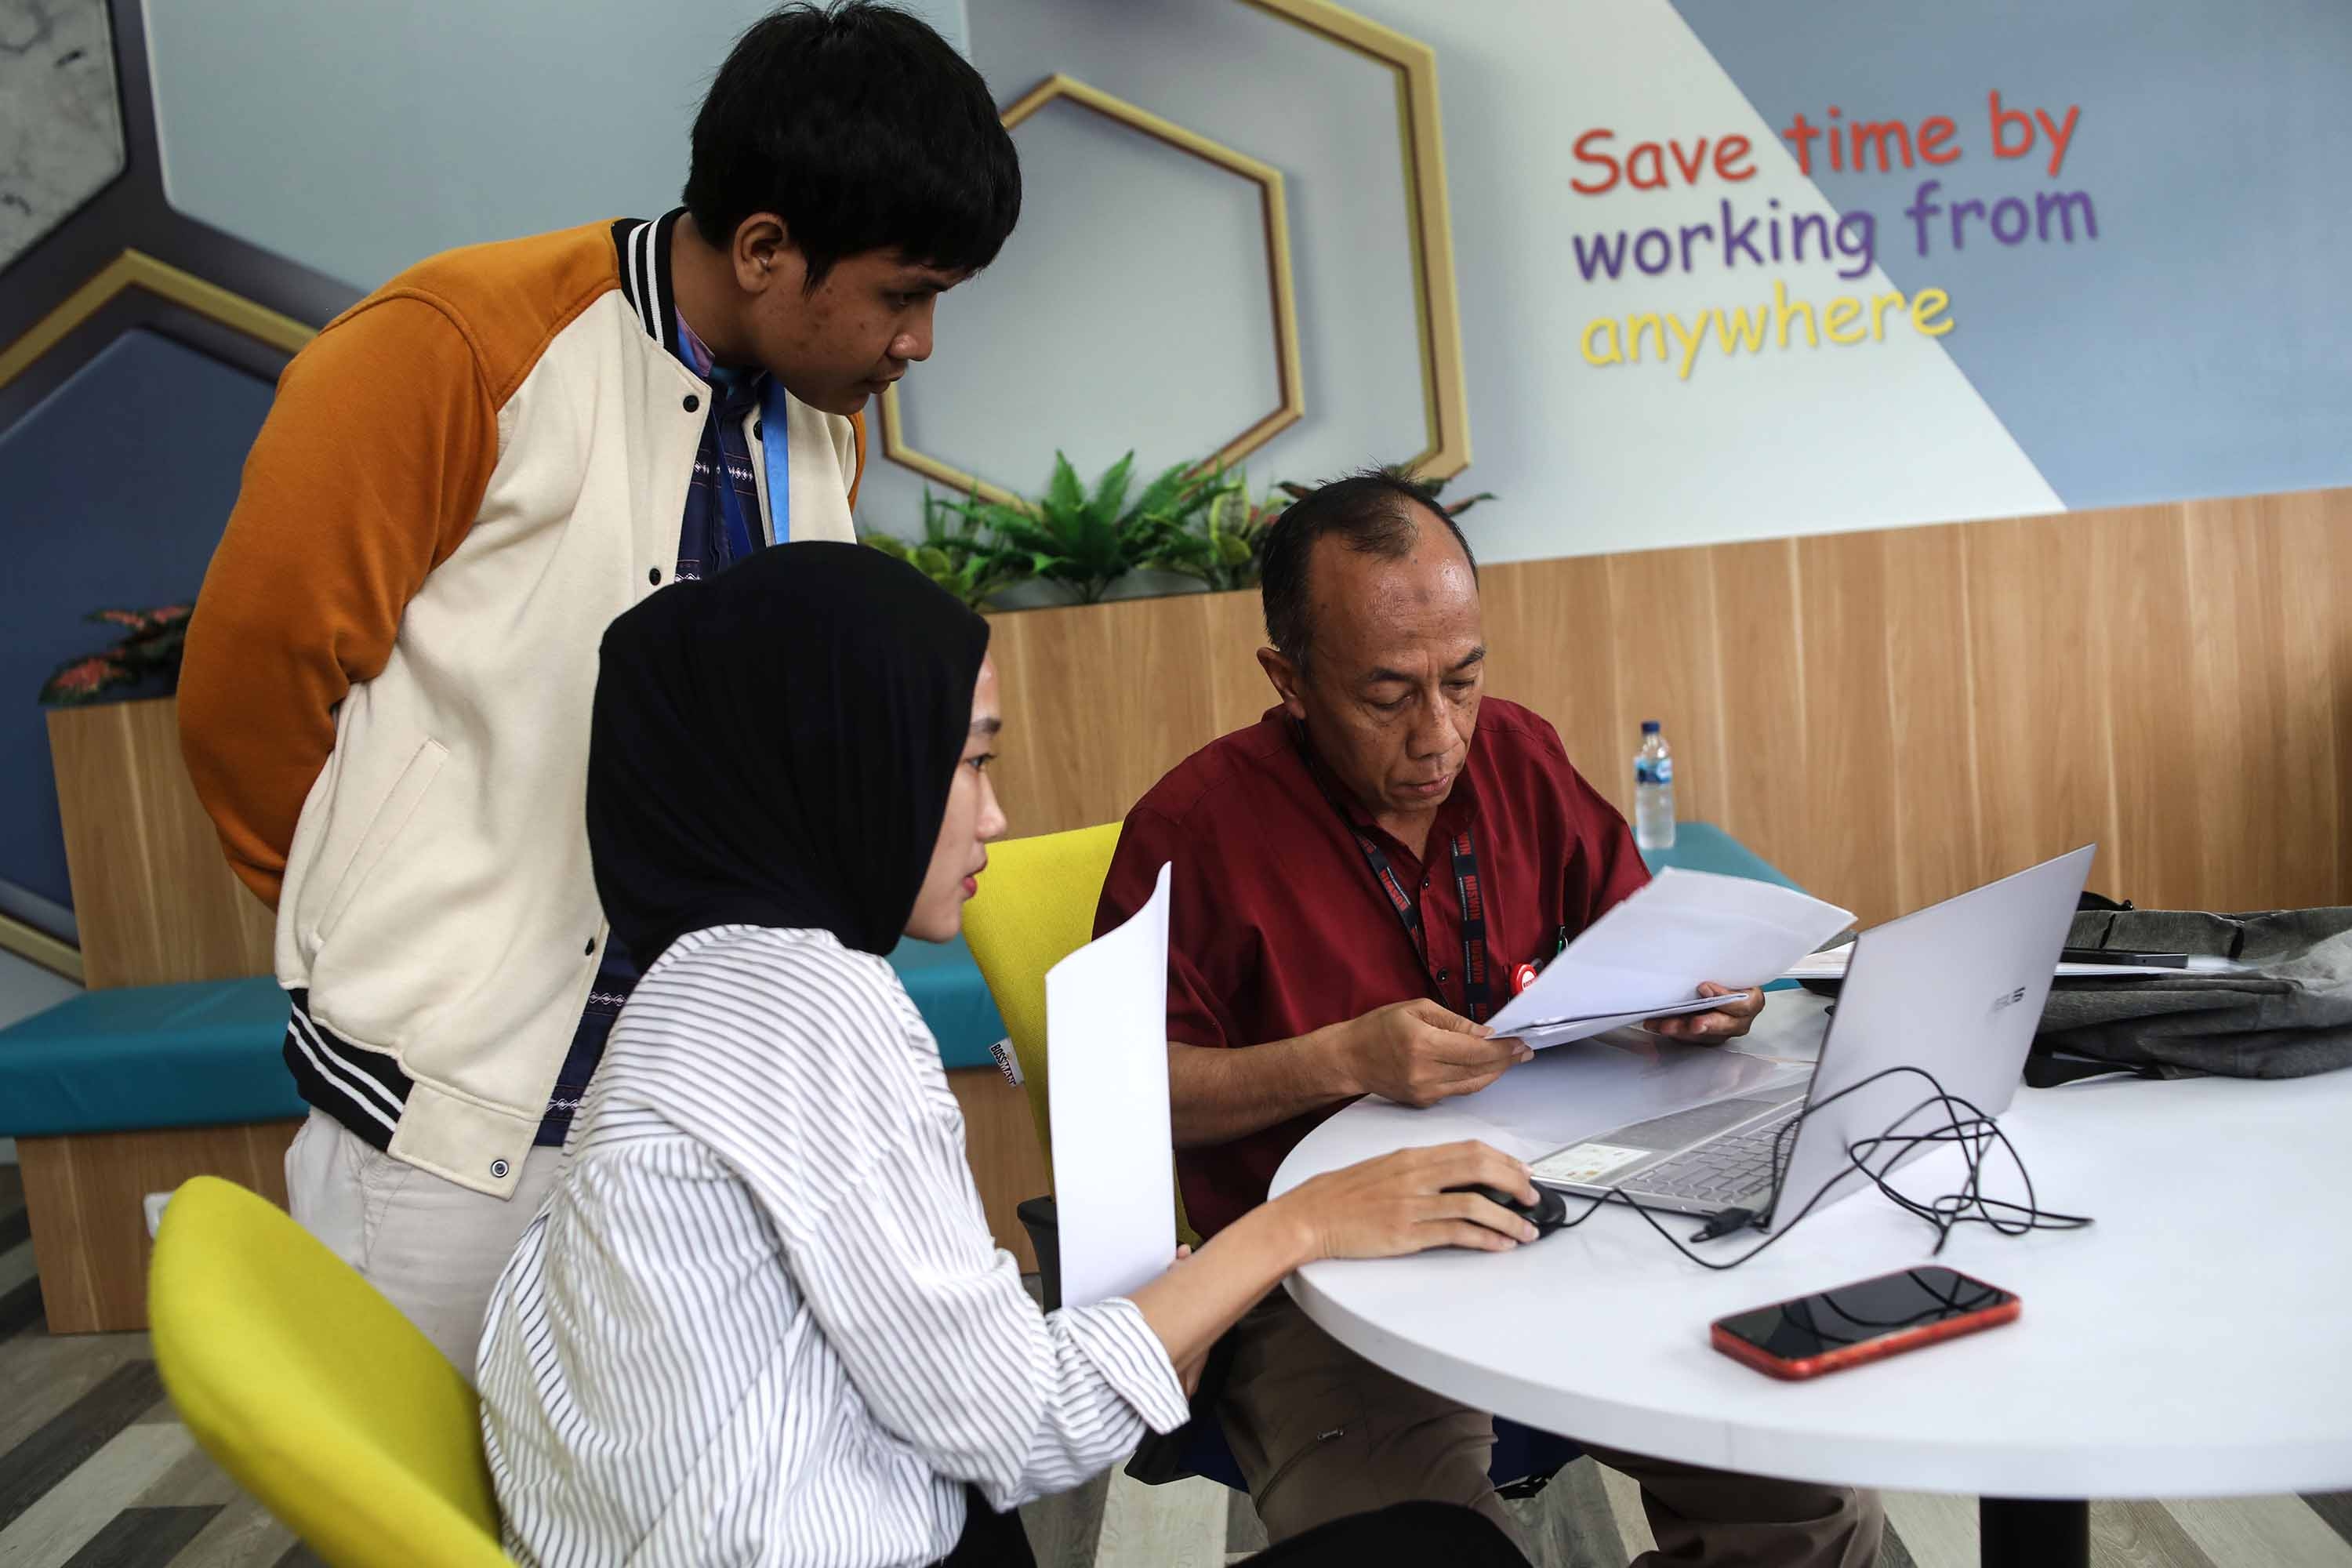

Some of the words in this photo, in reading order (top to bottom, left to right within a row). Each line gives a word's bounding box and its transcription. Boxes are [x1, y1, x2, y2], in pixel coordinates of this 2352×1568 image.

[1570, 129, 1758, 196] Save
[1783, 107, 1962, 177] time
[1989, 90, 2081, 178] by
[1573, 198, 1877, 281] working
[1904, 180, 2099, 258] from
[1581, 279, 1955, 381] anywhere
